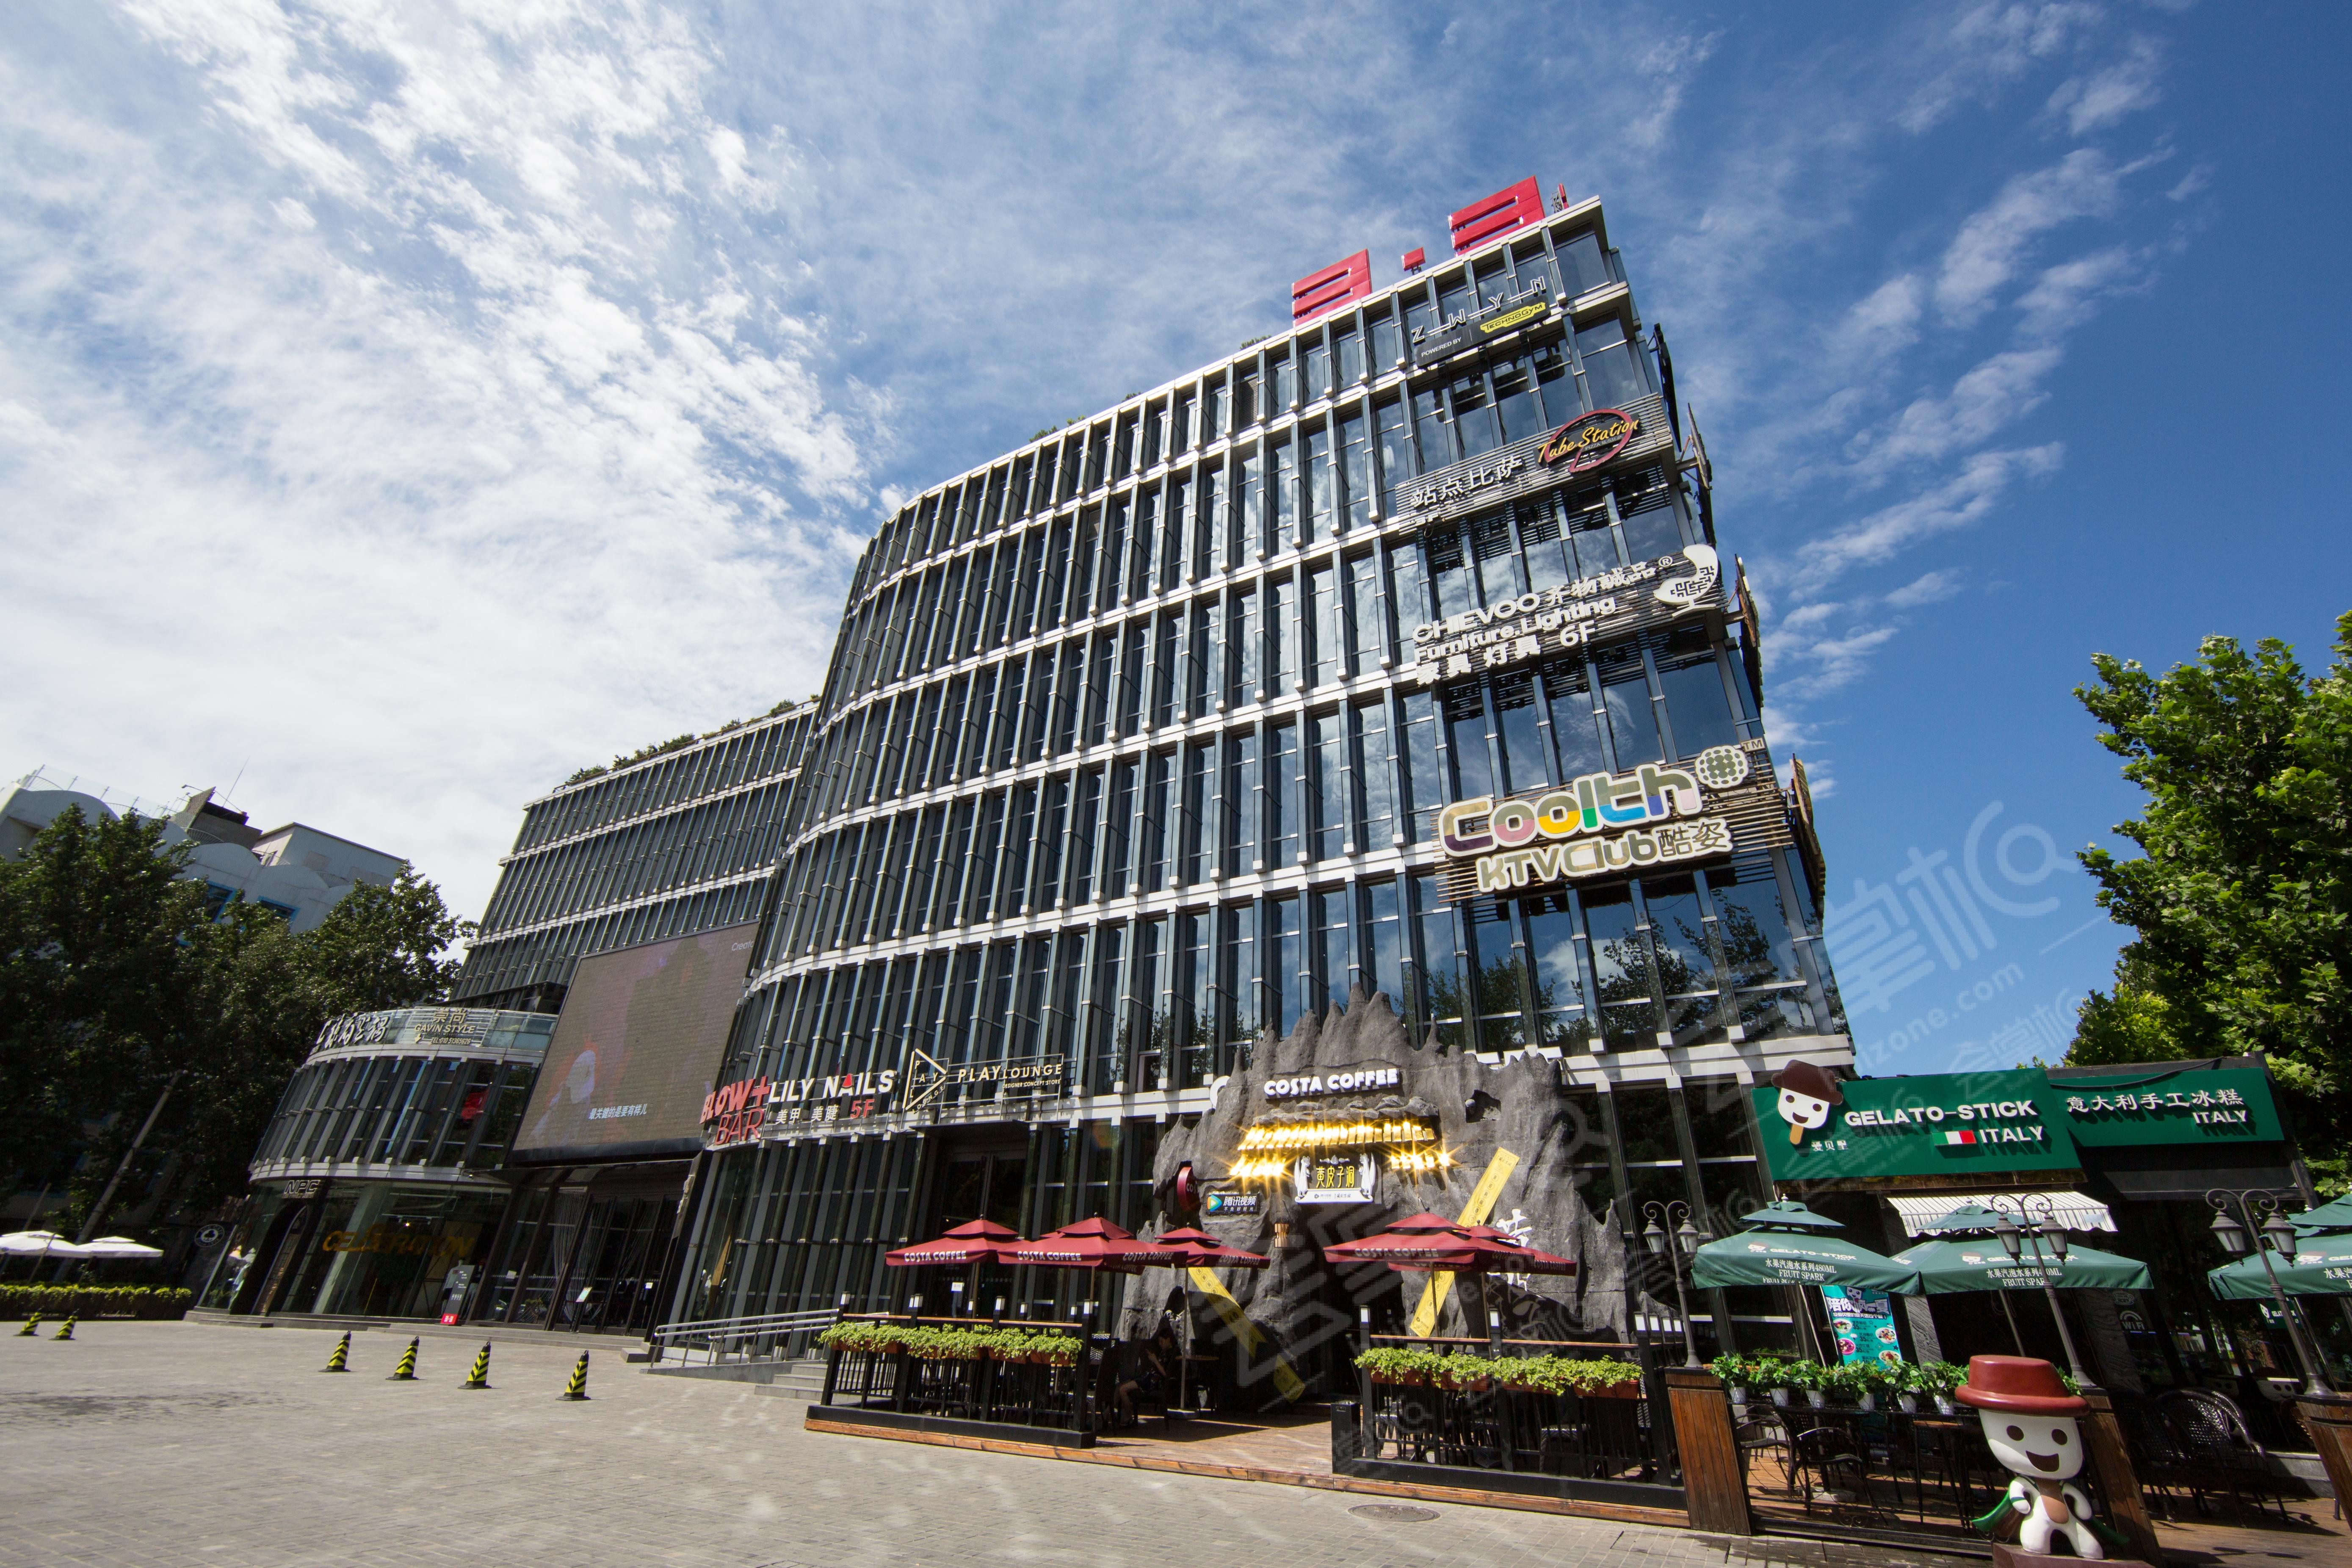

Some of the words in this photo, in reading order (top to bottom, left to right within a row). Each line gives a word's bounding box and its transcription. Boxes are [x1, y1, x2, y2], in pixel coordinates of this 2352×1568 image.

[1421, 340, 1452, 357] POWERED
[1452, 337, 1462, 345] BY
[1537, 437, 1579, 463] Tube
[1578, 419, 1639, 447] Station
[1412, 454, 1523, 508] 站点比萨
[1559, 619, 1596, 647] 6F
[414, 1023, 443, 1033] GAVIN
[445, 1024, 476, 1034] STYLE
[768, 1077, 816, 1103] LILY
[1263, 1076, 1324, 1096] COSTA
[1327, 1068, 1398, 1090] COFFEE
[2066, 1088, 2244, 1113] 意大利手工冰糕
[776, 1107, 801, 1125] 美甲
[850, 1098, 875, 1119] 5F
[1844, 1100, 2038, 1126] GELATO-STICK
[2192, 1110, 2248, 1124] ITALY
[714, 1108, 767, 1146] BAR
[1979, 1126, 2043, 1144] ITALY
[1316, 1166, 1355, 1188] 黄皮子洞
[284, 1180, 321, 1194] NPC
[1223, 1196, 1257, 1206] 腾讯视频
[904, 1252, 931, 1262] COSTA
[933, 1250, 967, 1261] COFFEE
[1017, 1251, 1046, 1261] COSTA
[1047, 1251, 1082, 1261] COFFEE
[1122, 1252, 1147, 1261] COSTA
[1147, 1252, 1174, 1261] COFFEE
[1355, 1248, 1392, 1258] COSTA
[1393, 1248, 1439, 1258] COFFEE
[1778, 1269, 1800, 1279] FRUIT
[1801, 1272, 1825, 1282] SPARK
[1986, 1267, 2062, 1278] 水果汽泡水系列40ML
[2002, 1277, 2025, 1287] FRUIT
